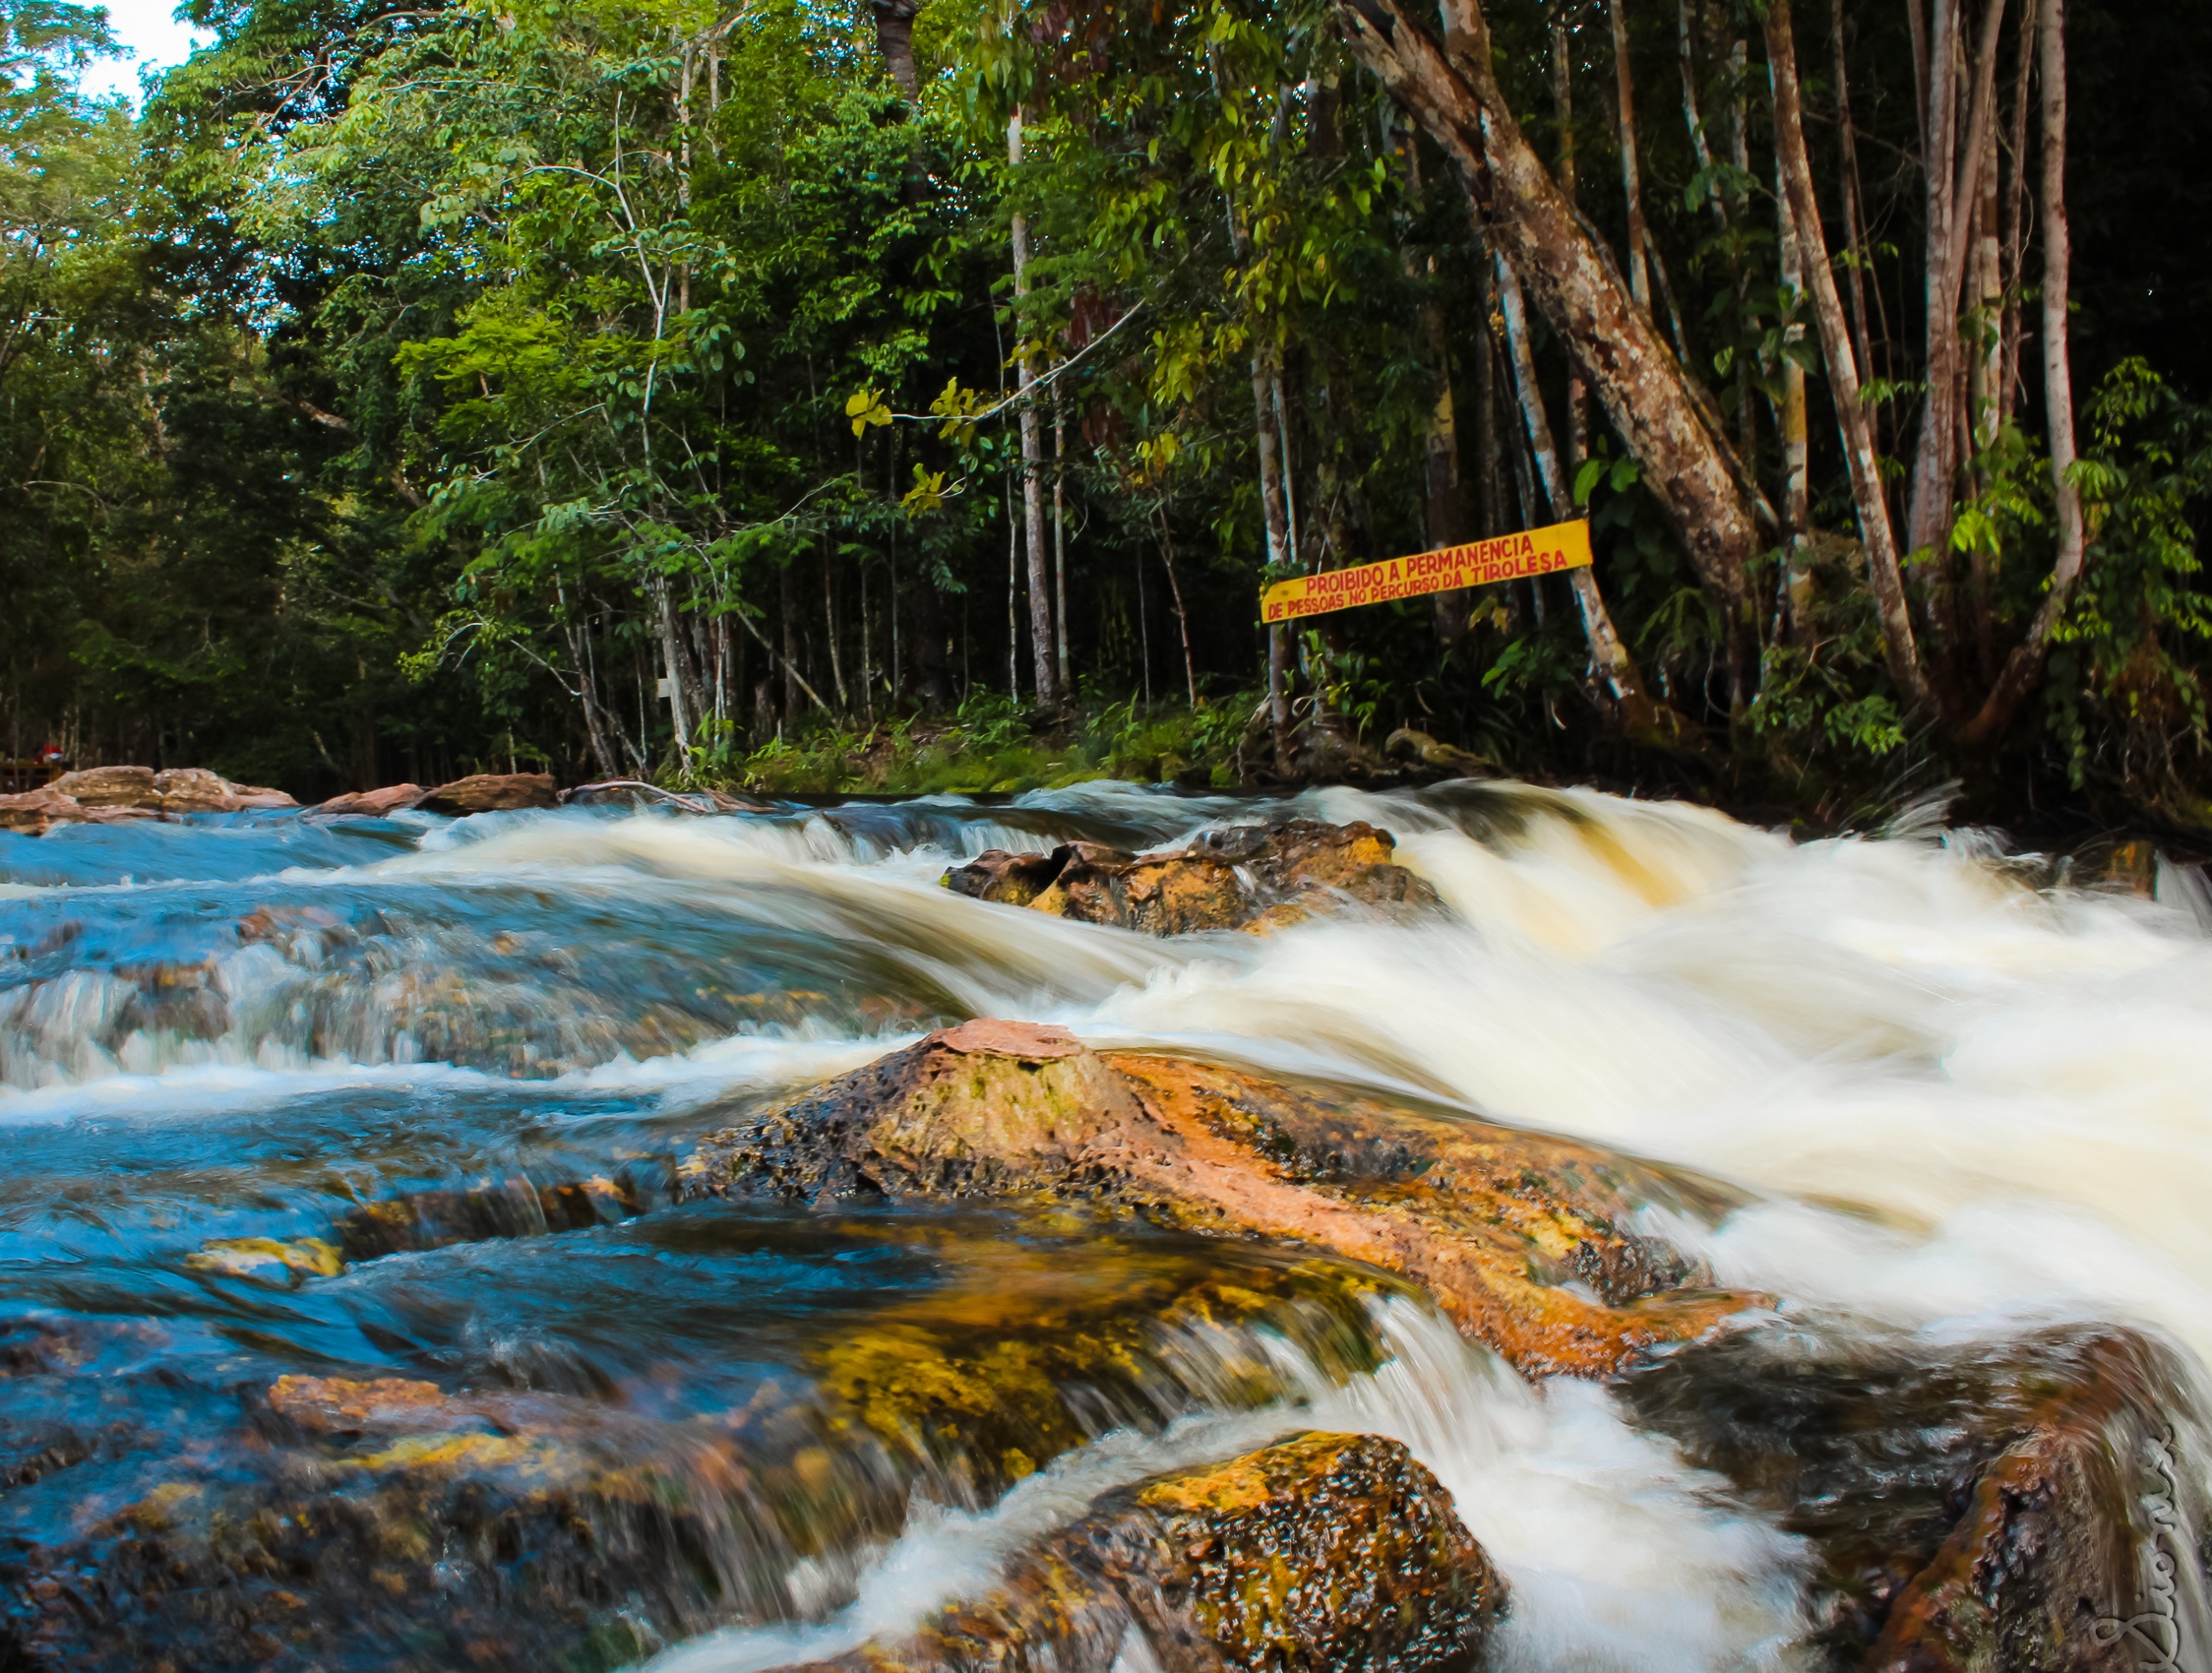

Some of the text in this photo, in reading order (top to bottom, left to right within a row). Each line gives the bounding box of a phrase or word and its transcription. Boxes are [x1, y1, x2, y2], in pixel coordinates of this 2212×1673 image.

[1268, 550, 1567, 620] DE PESSOAS NO PERCURSO DA TIROLESA
[1307, 566, 1383, 595] PROIBIDO
[1389, 561, 1400, 582] A
